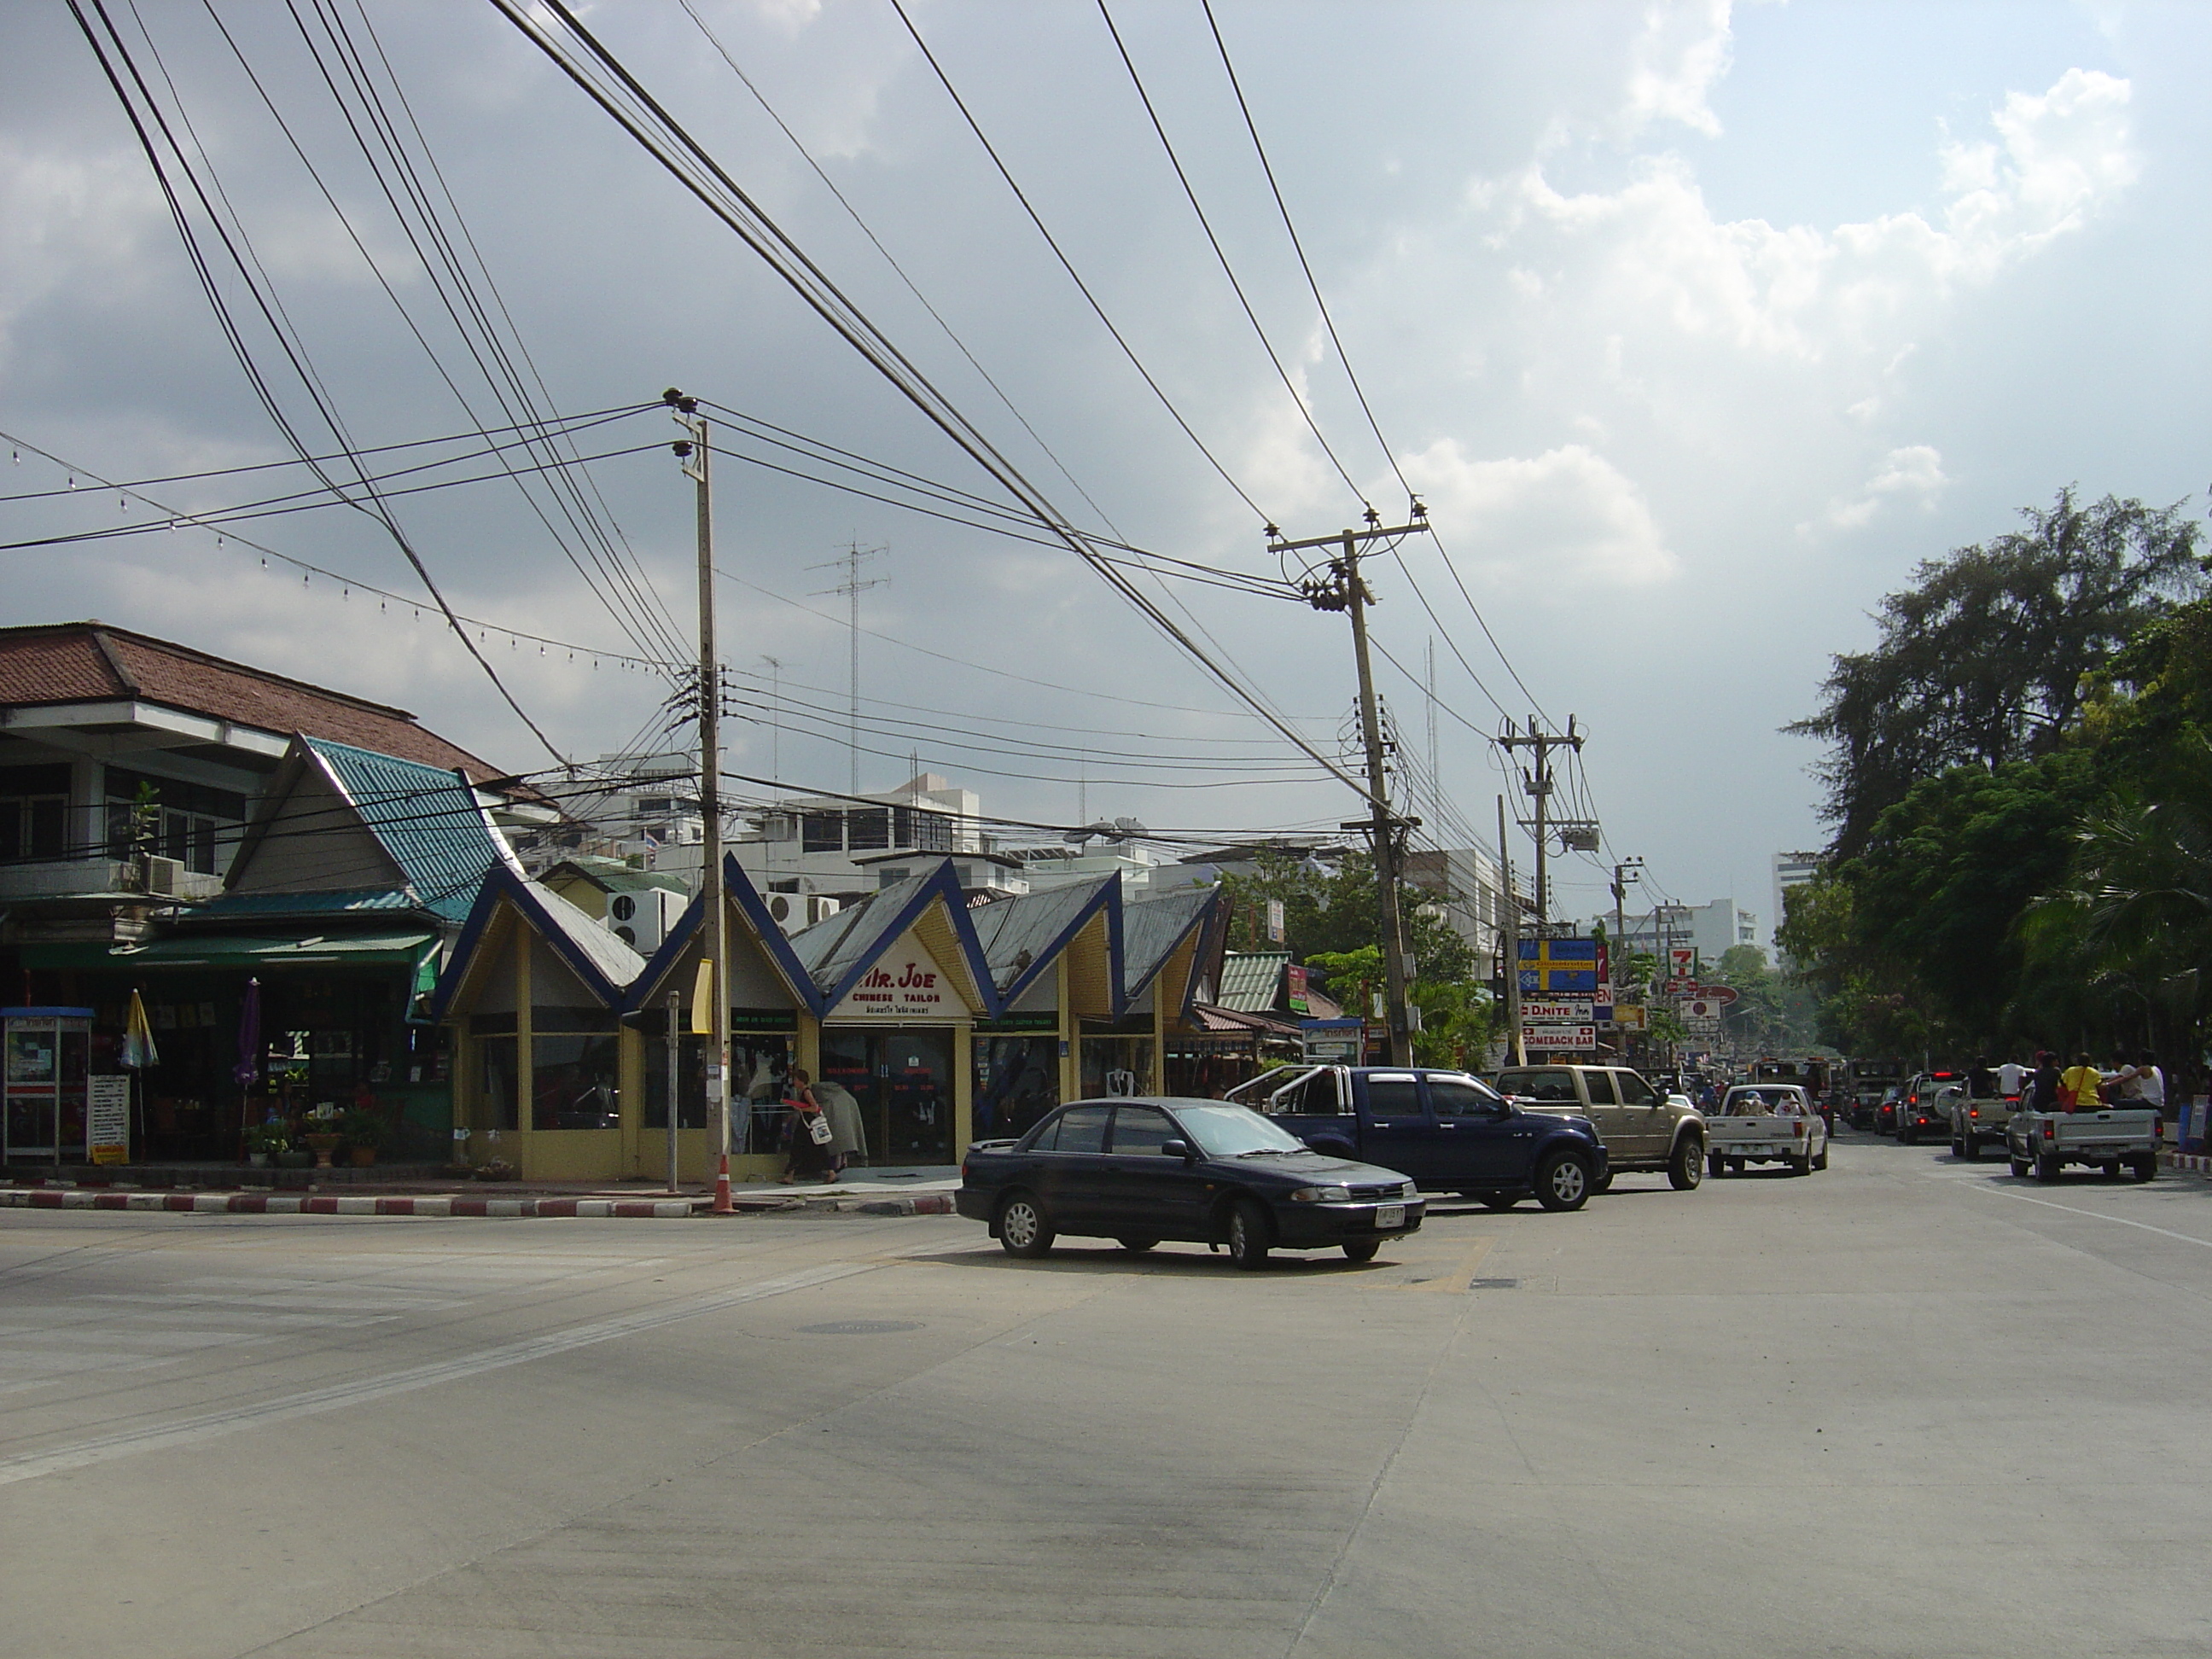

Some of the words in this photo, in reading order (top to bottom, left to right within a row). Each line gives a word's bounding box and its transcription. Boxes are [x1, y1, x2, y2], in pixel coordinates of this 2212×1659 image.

[1673, 950, 1691, 975] 7
[853, 993, 894, 1003] CHINESE
[905, 993, 940, 1003] TAILOR
[1531, 1004, 1571, 1016] D.NITE
[1522, 1035, 1574, 1045] COMEBACK
[1575, 1035, 1593, 1045] BAR
